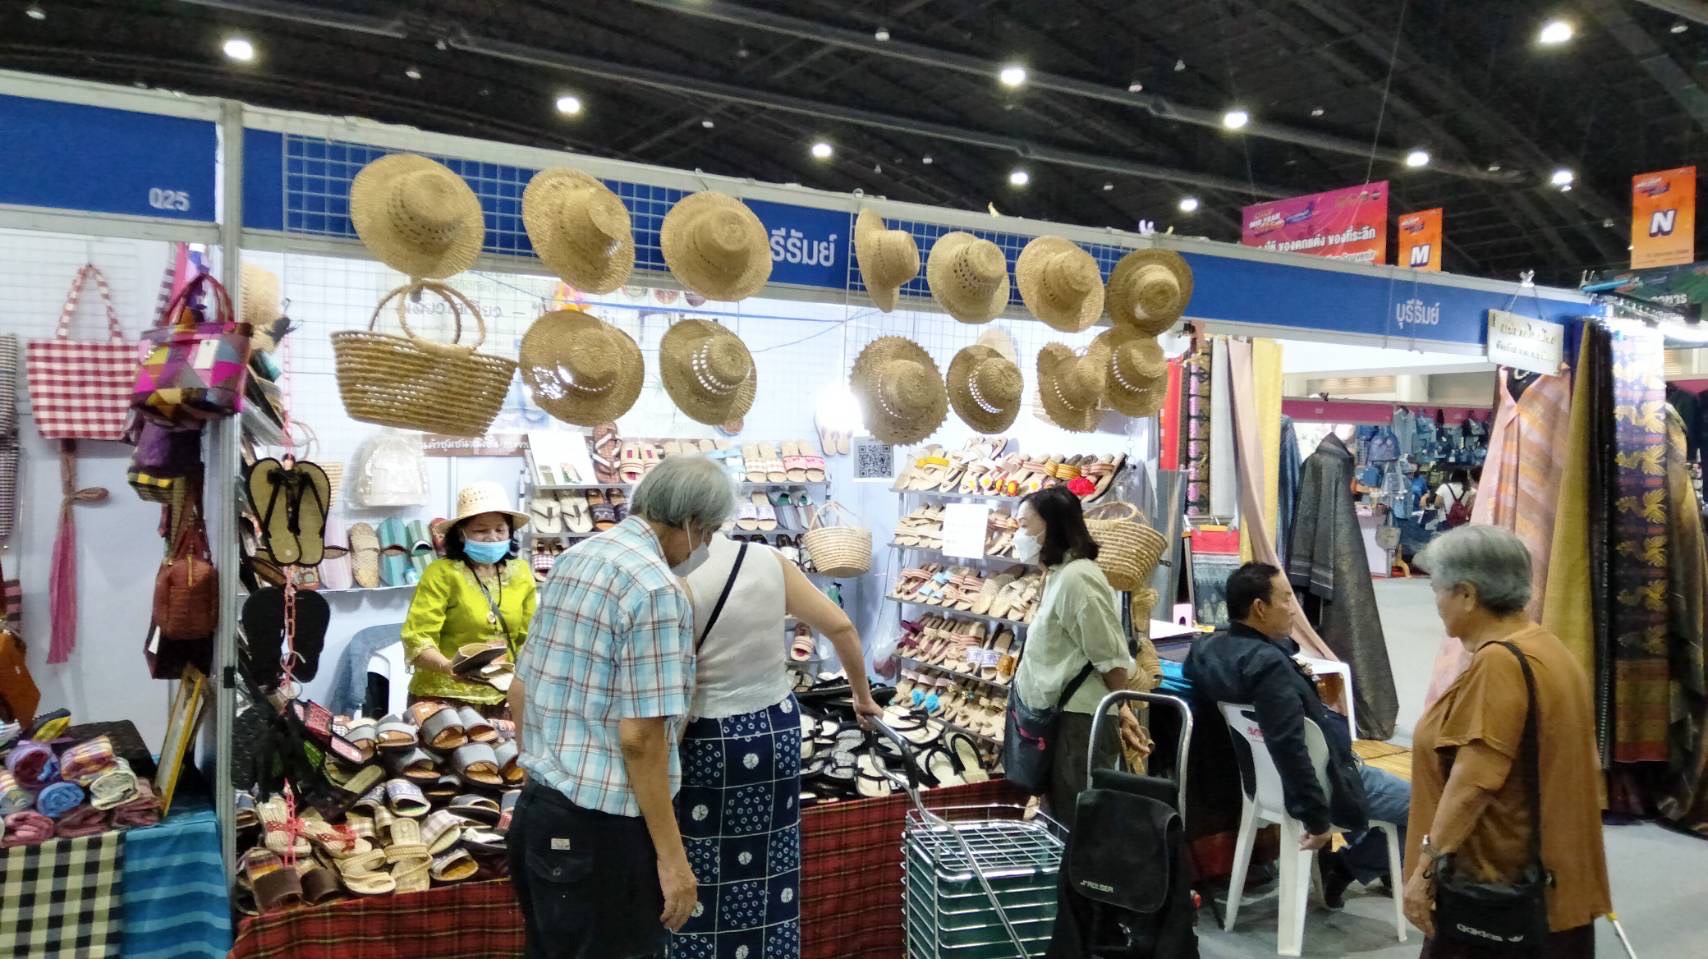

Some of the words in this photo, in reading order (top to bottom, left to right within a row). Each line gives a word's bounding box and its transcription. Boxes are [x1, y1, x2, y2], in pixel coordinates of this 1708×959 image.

[1328, 224, 1377, 246] ของที่ระลึก
[1650, 209, 1676, 236] N
[769, 227, 838, 267] รีรัมย์
[1410, 244, 1431, 266] M
[1396, 298, 1441, 330] บุรีรัมย์
